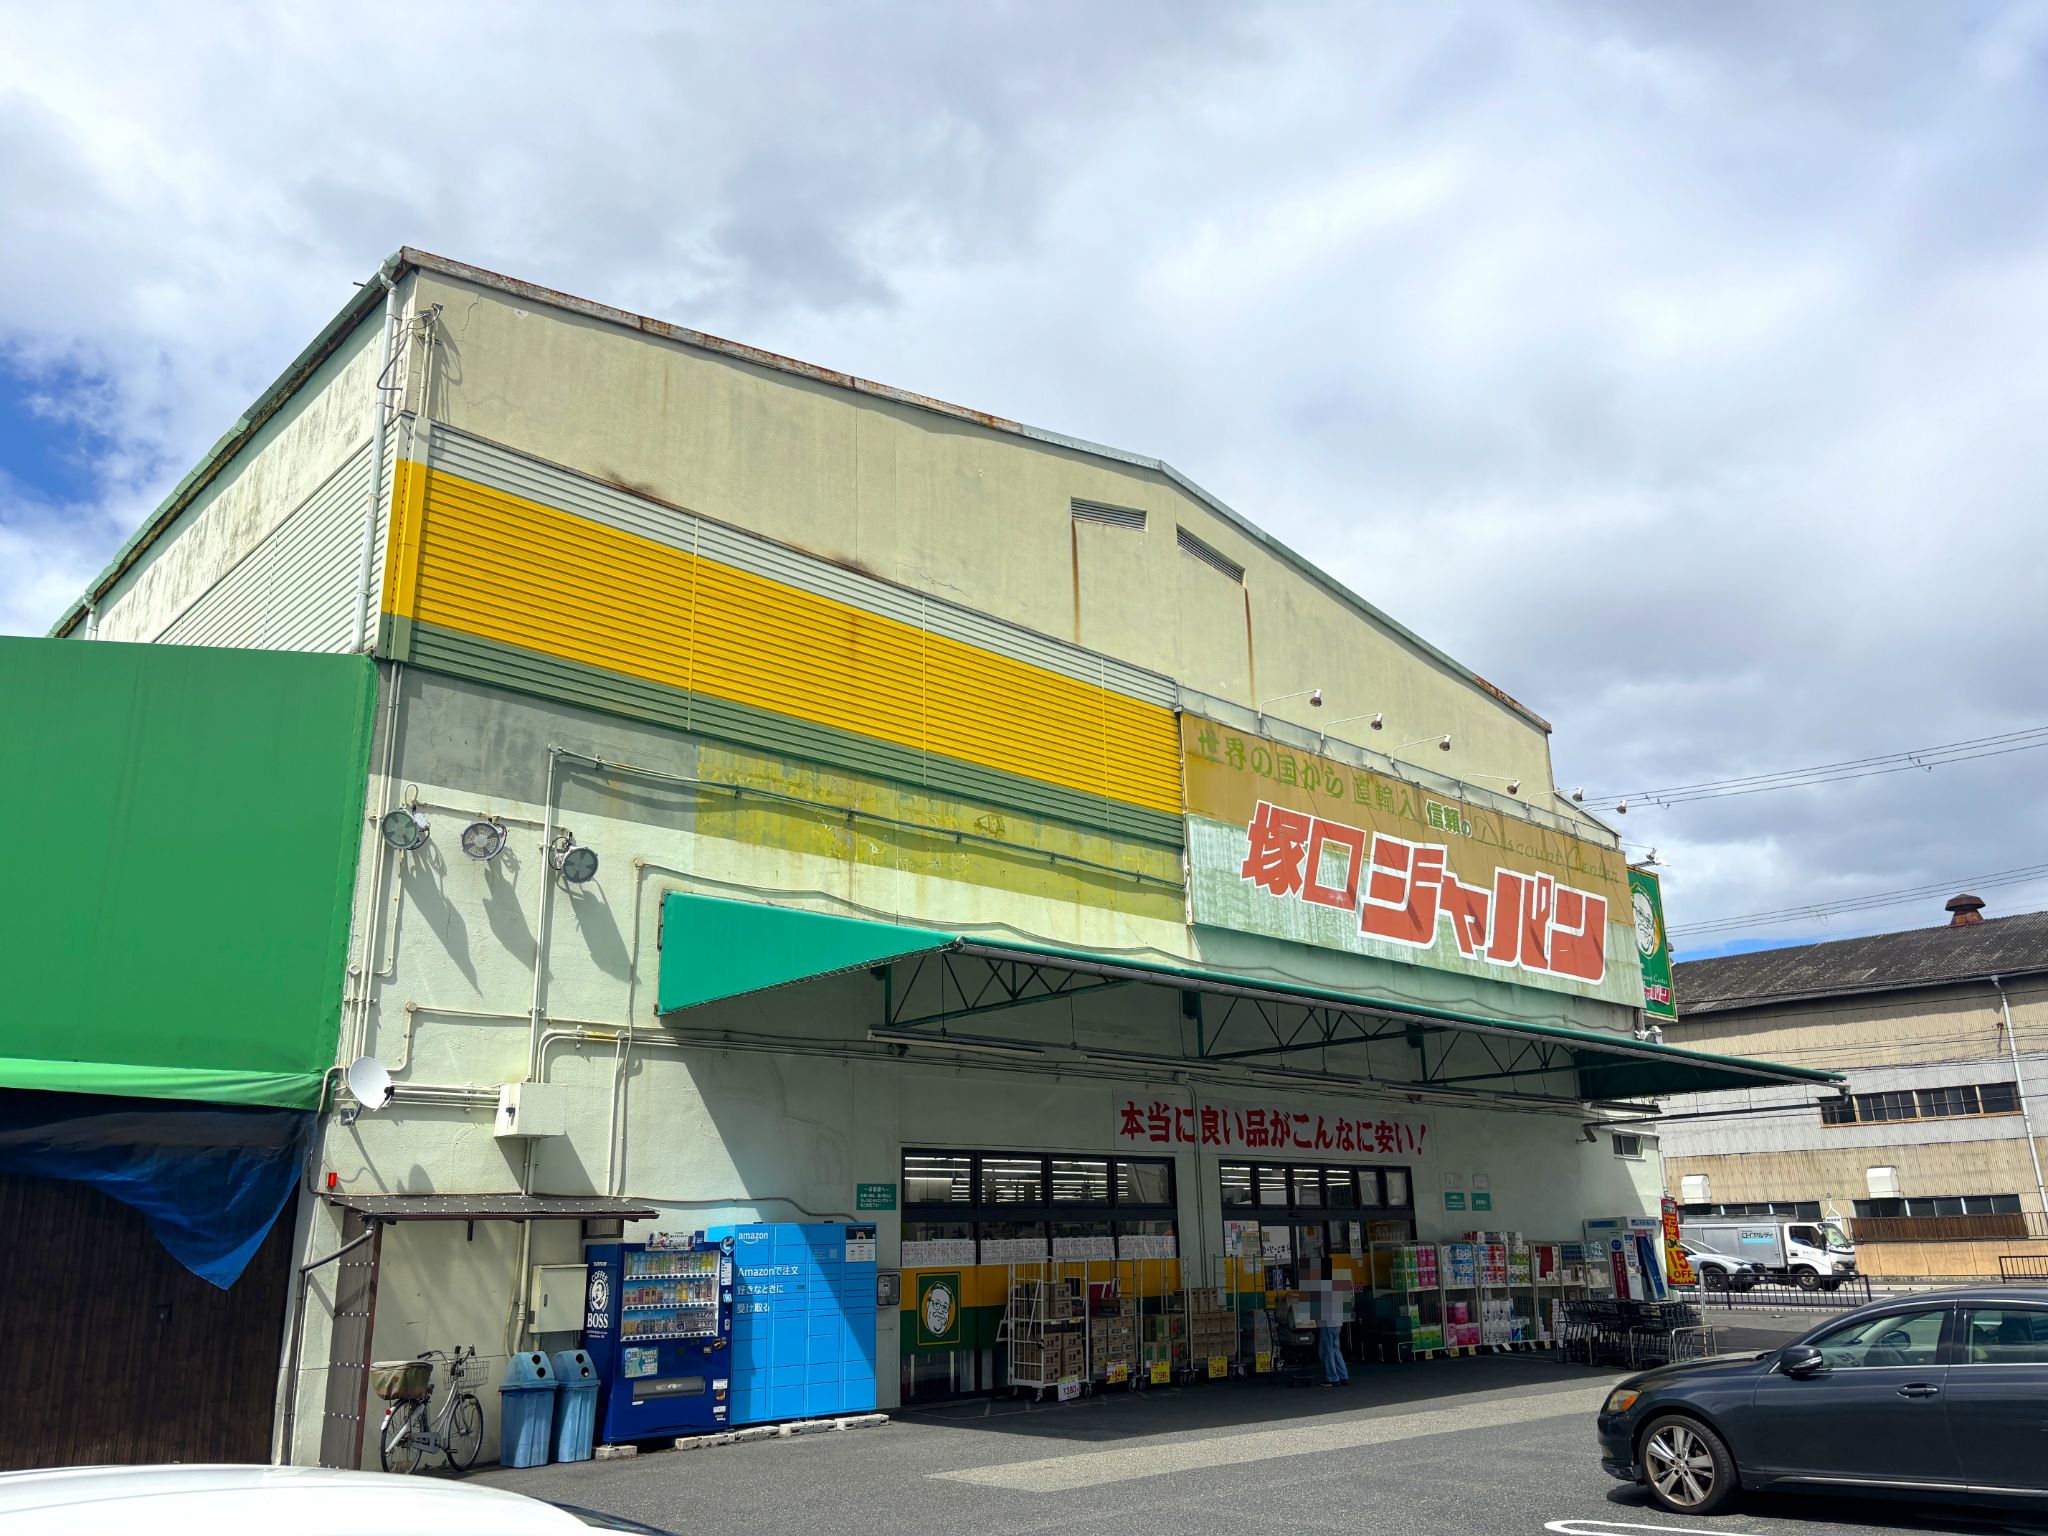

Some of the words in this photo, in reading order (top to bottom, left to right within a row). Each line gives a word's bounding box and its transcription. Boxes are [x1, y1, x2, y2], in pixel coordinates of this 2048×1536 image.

[1198, 729, 1344, 799] 世界の国から
[1353, 774, 1417, 819] 直輸入
[1427, 799, 1472, 838] 信頼の
[1241, 800, 1608, 985] 塚口ジャパン
[738, 1231, 769, 1241] amazon
[1668, 1249, 1689, 1270] 15
[591, 1270, 609, 1283] COFFEE
[737, 1265, 799, 1277] Amazonで注文
[1674, 1270, 1694, 1279] OFF
[737, 1284, 785, 1296] 好きなときに
[736, 1302, 771, 1314] 受け取る
[587, 1312, 609, 1329] BOSS
